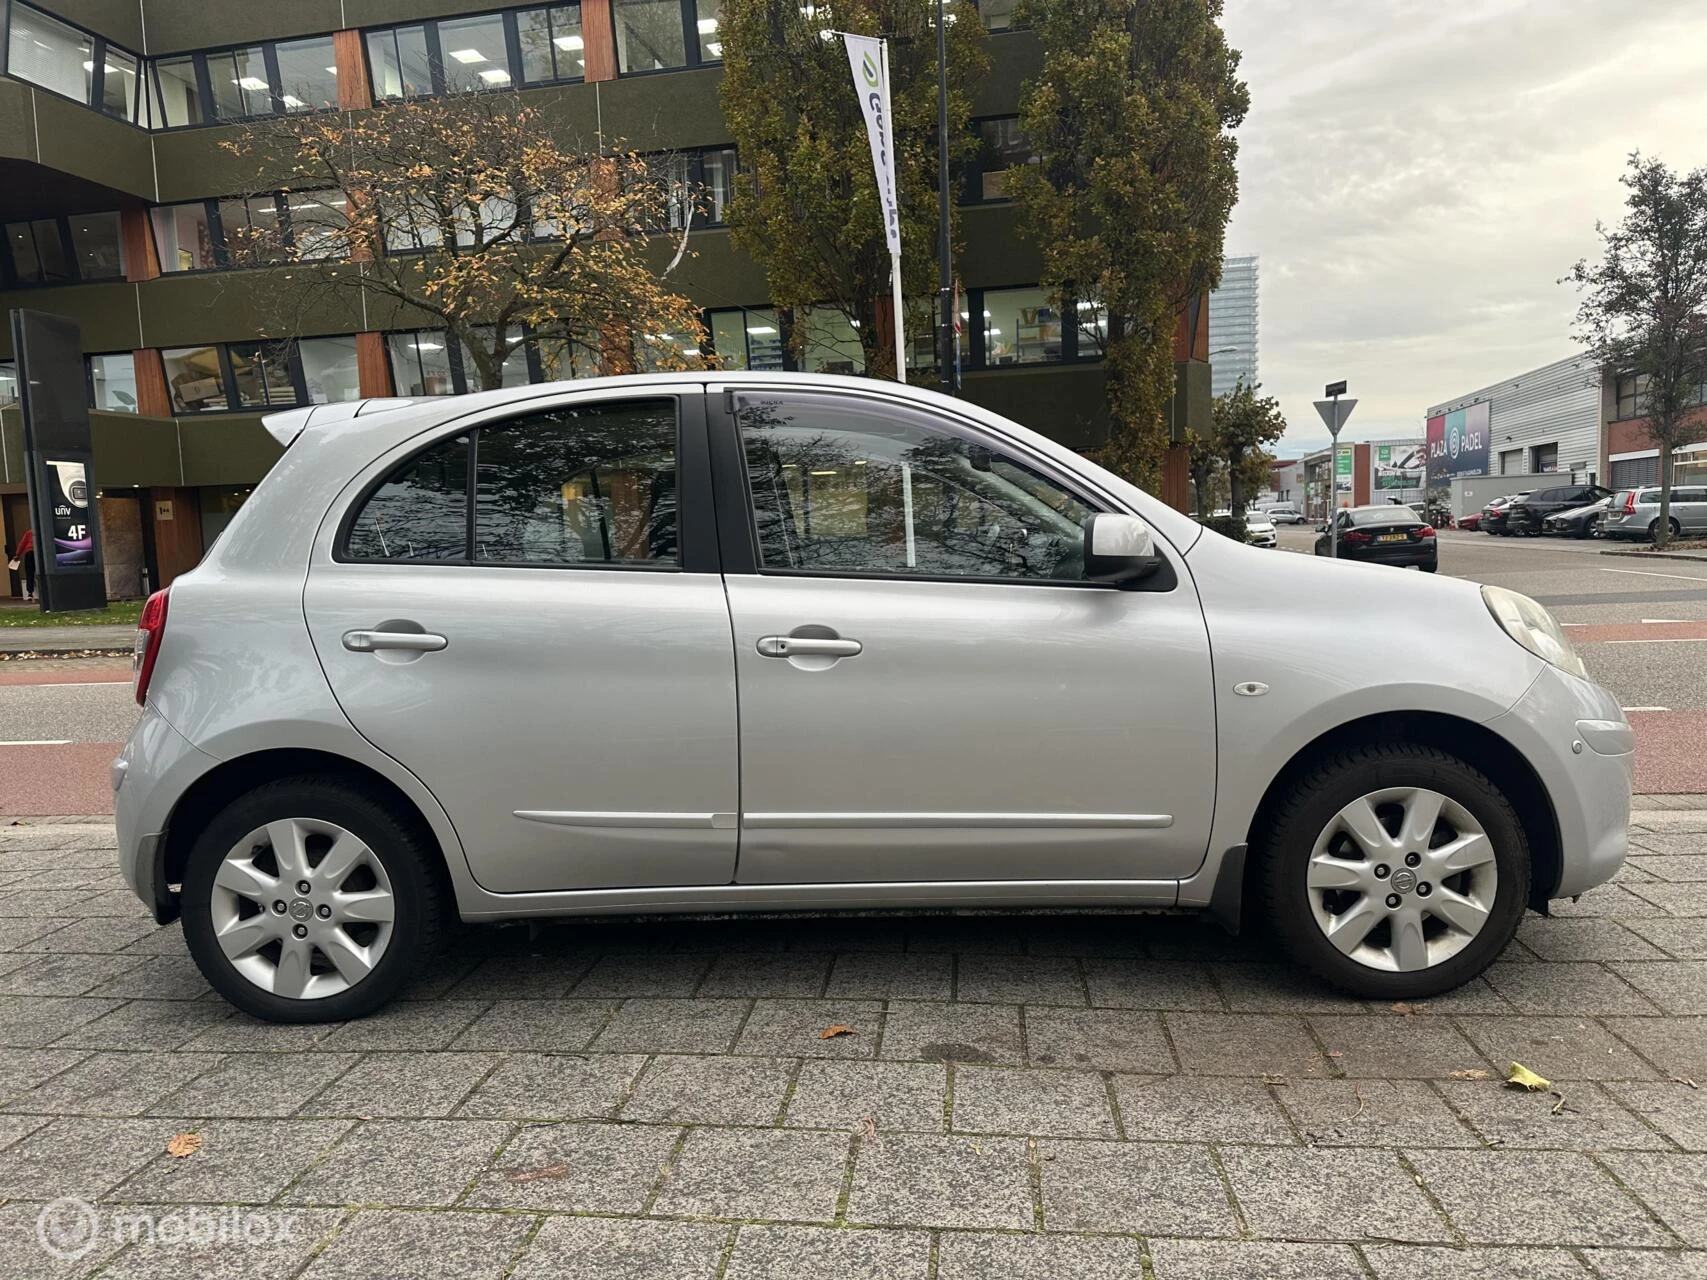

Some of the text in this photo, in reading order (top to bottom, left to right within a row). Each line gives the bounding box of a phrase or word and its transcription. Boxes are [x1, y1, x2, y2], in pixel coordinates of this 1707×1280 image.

[1430, 431, 1483, 458] PLAZA PADEL
[68, 525, 86, 540] 4F
